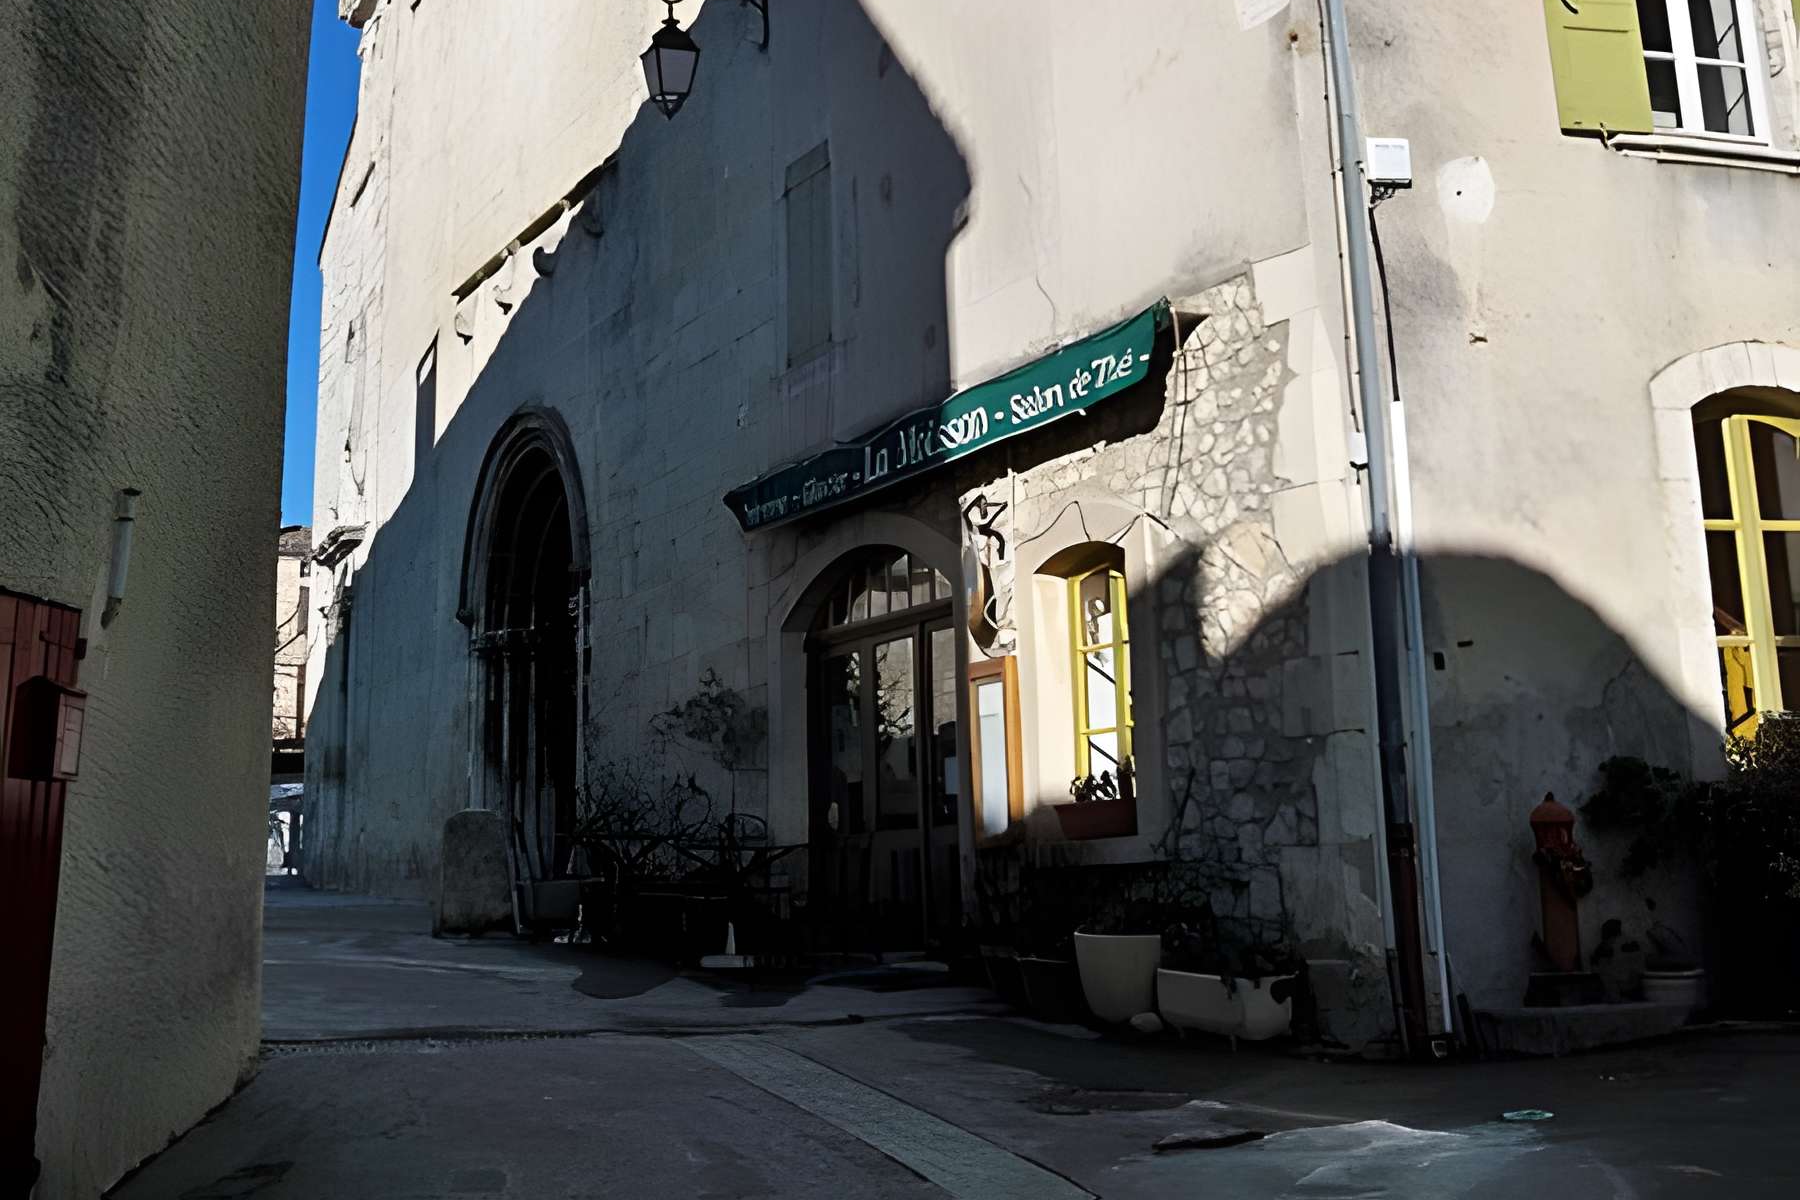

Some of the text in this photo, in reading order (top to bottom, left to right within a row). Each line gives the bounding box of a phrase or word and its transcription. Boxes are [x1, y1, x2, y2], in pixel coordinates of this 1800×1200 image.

[1010, 384, 1064, 425] Salon
[1069, 367, 1092, 399] de
[1091, 348, 1133, 388] Thé
